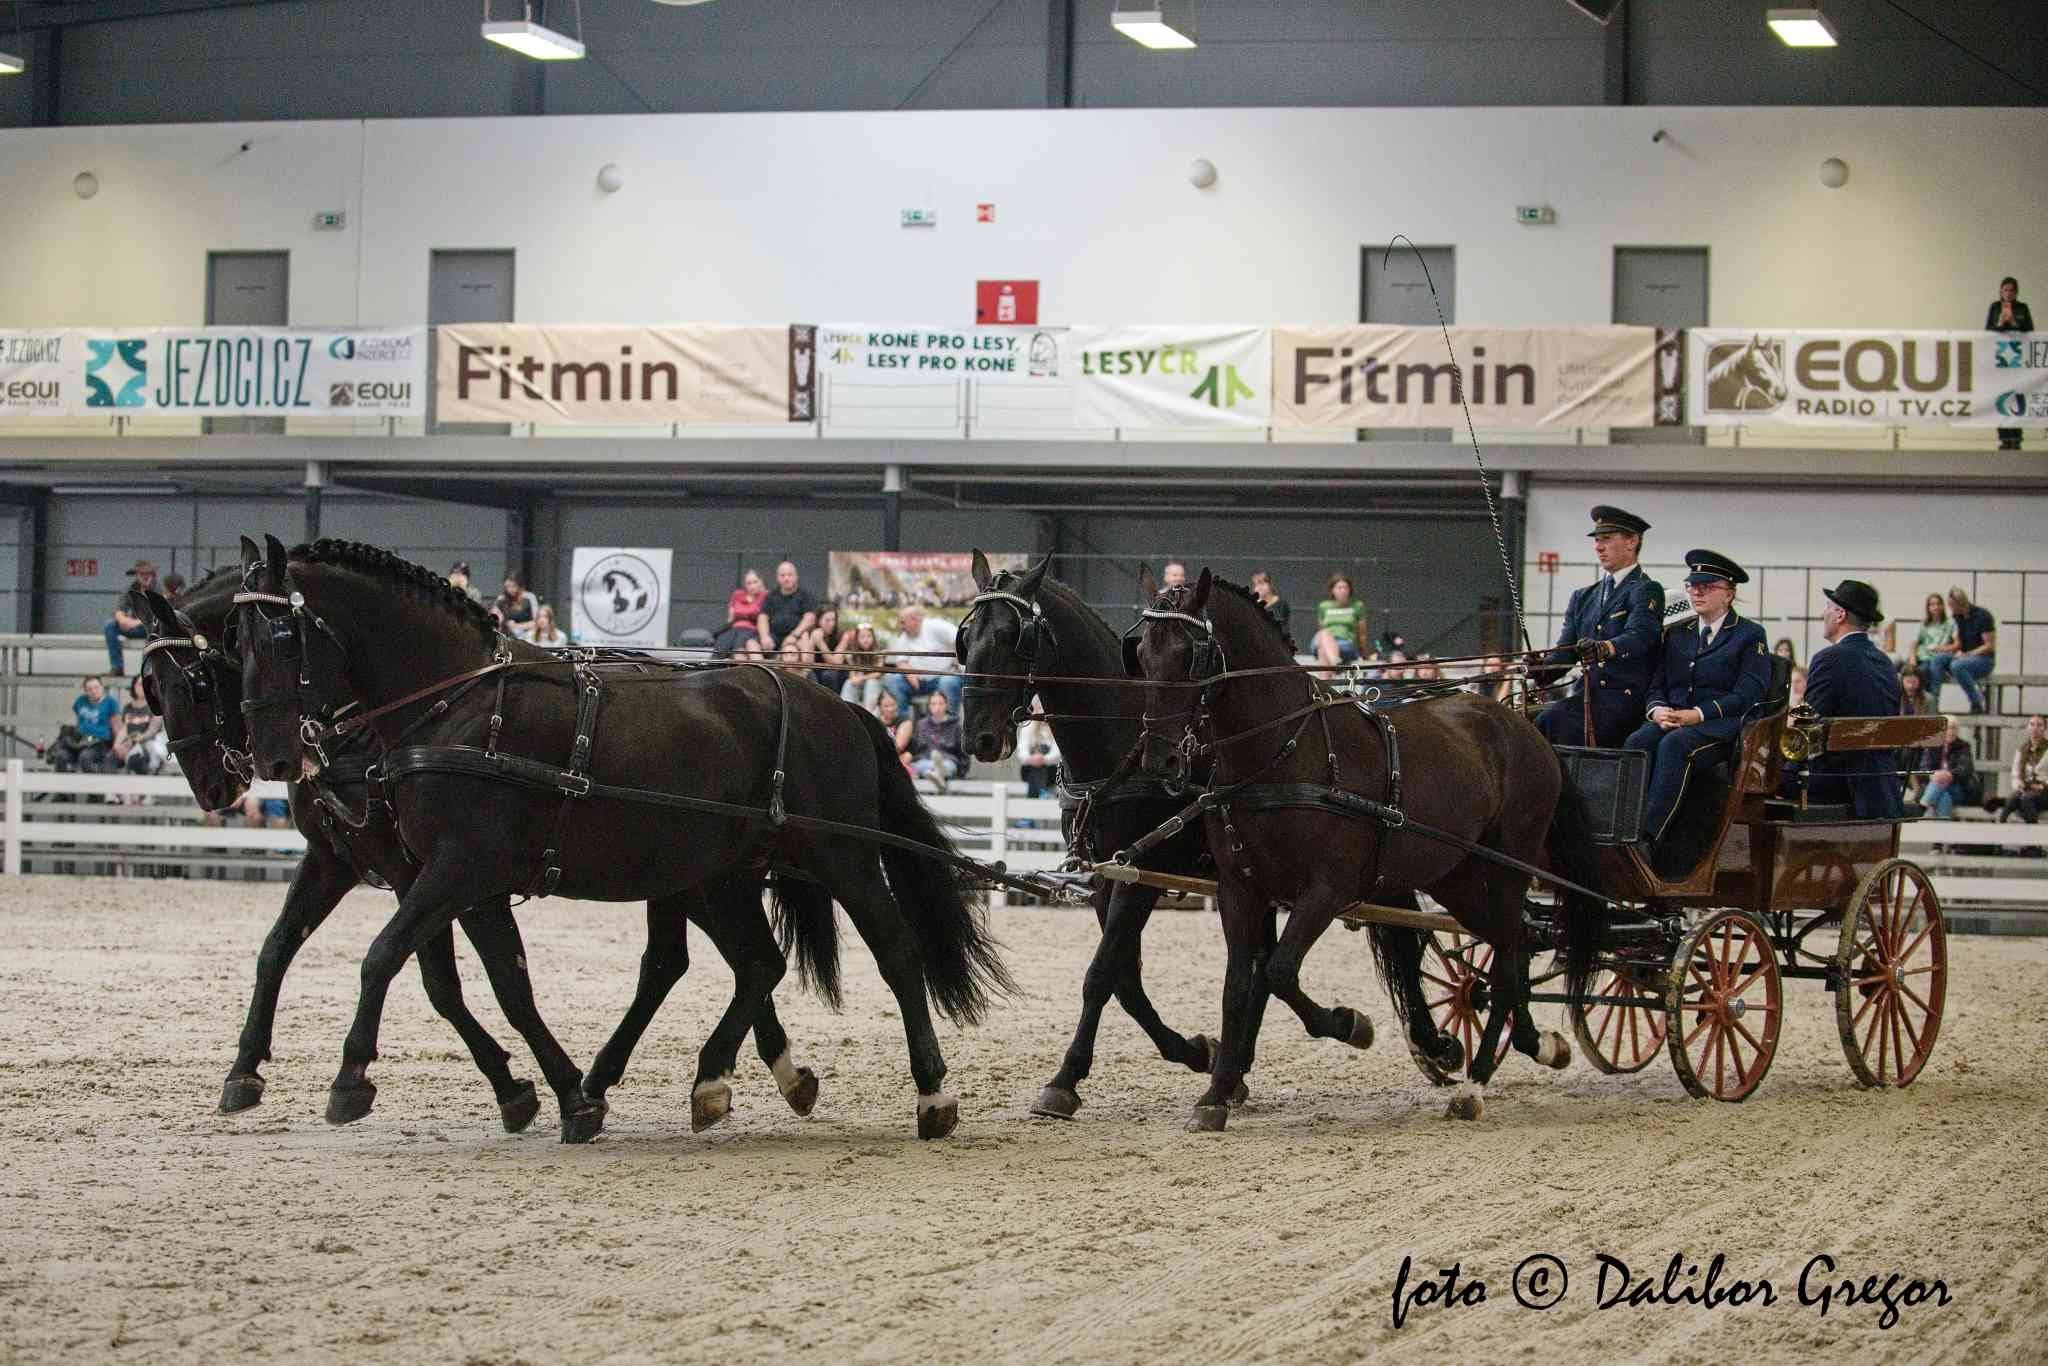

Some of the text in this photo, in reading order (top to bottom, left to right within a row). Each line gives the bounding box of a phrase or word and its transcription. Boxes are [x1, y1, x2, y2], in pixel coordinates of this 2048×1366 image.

[927, 335, 964, 349] PRO
[867, 353, 910, 368] LESY
[919, 355, 956, 370] PRO
[1795, 339, 1973, 392] EQUI
[156, 338, 311, 407] JEZDCI.CZ
[457, 345, 677, 401] Fitmin
[1294, 347, 1535, 405] Fitmin
[8, 381, 59, 398] EQUI
[357, 383, 411, 400] EQUI
[1797, 399, 1972, 417] RADIO TV.CZ
